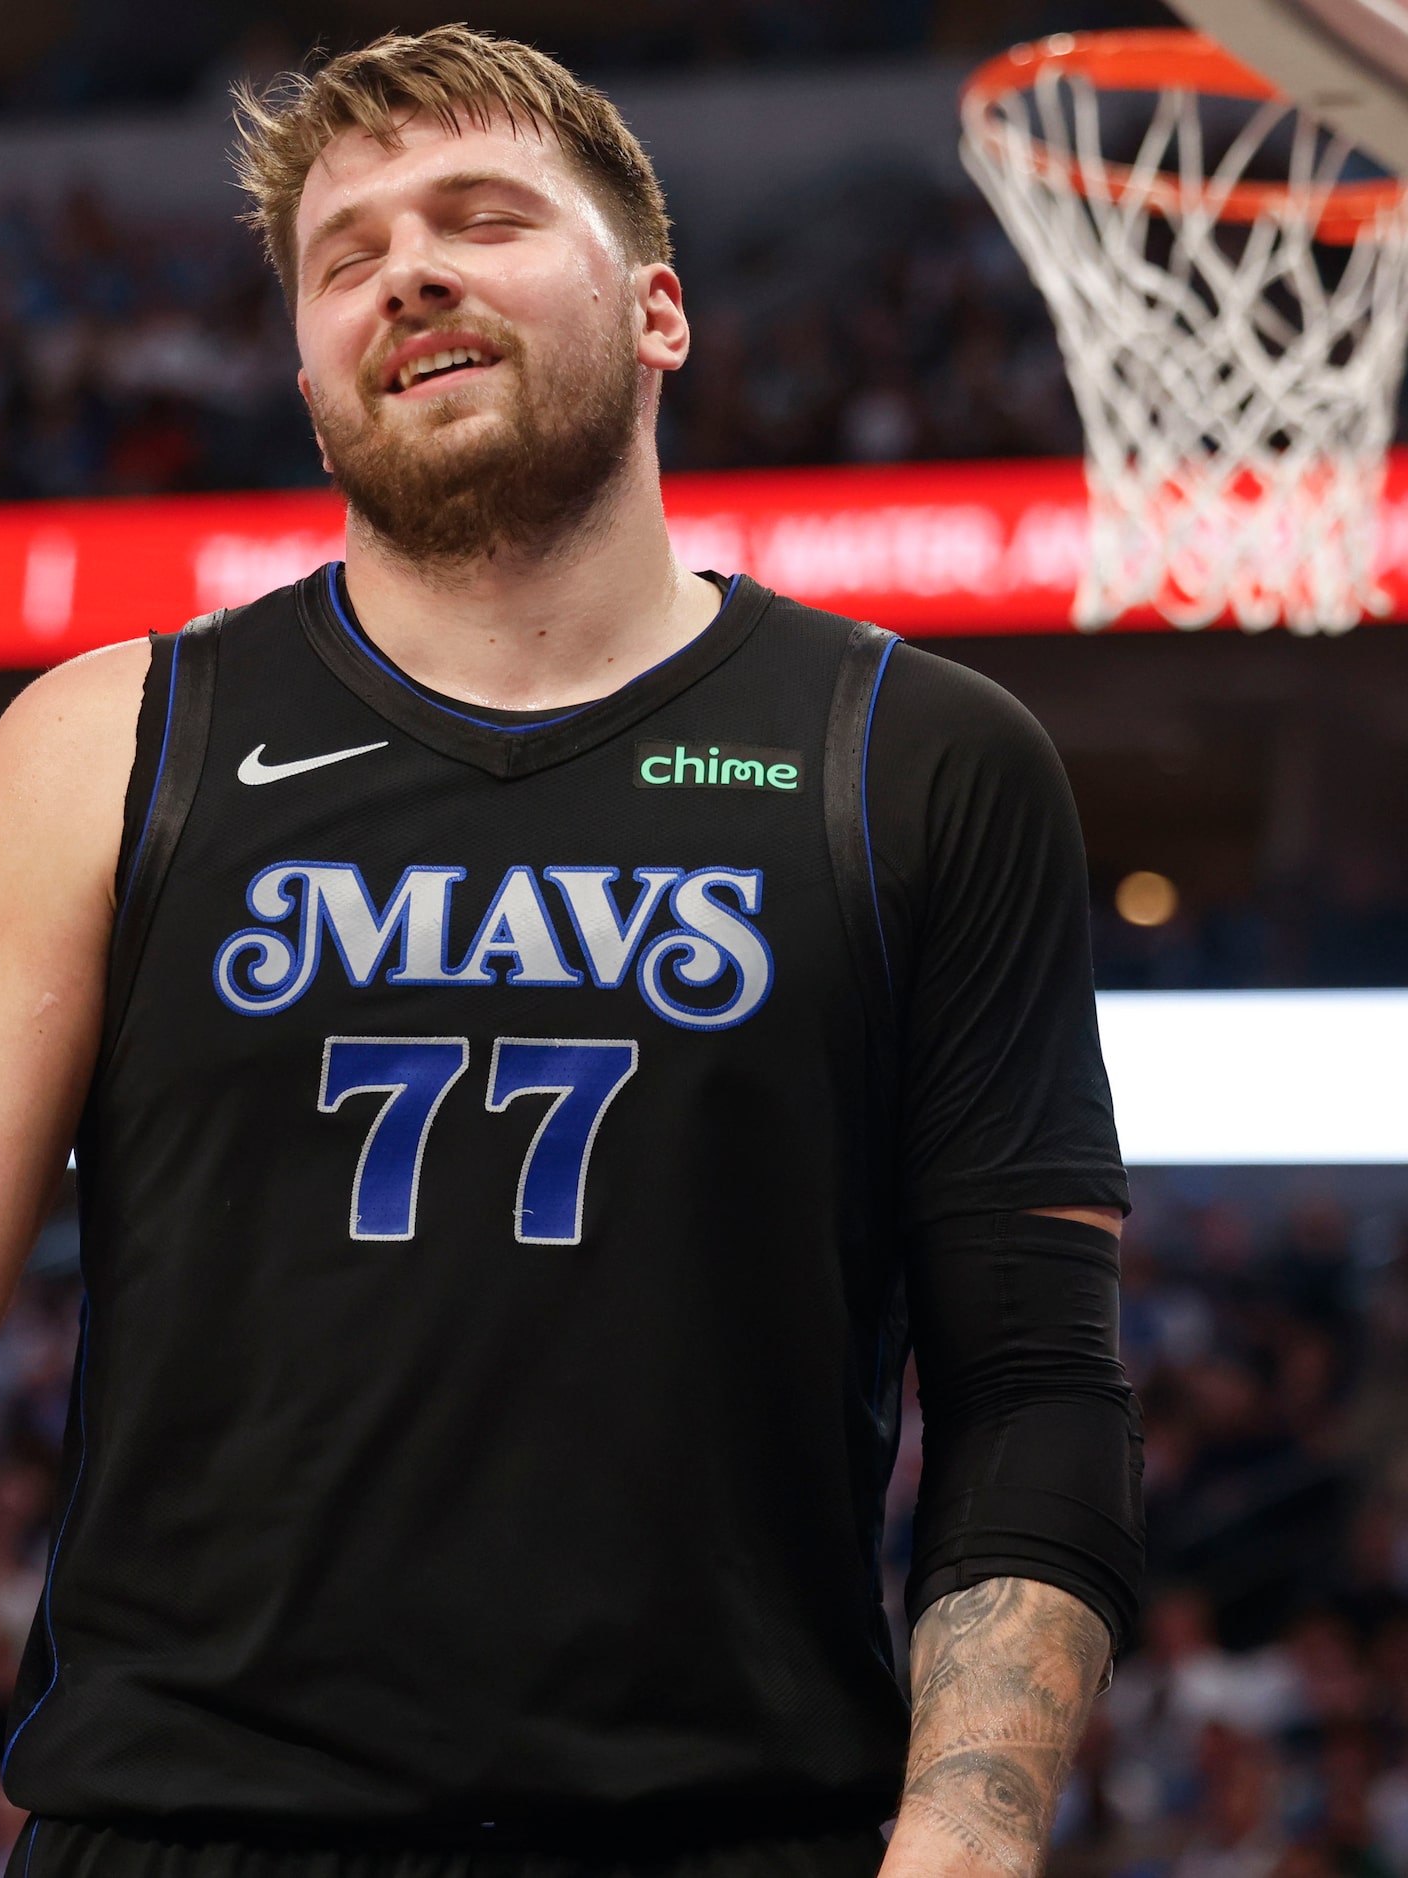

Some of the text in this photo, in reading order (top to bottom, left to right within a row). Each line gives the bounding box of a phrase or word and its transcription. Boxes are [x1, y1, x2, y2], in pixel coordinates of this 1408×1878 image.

[640, 745, 798, 790] chime
[213, 861, 774, 1030] MAVS
[317, 1036, 639, 1245] 77
